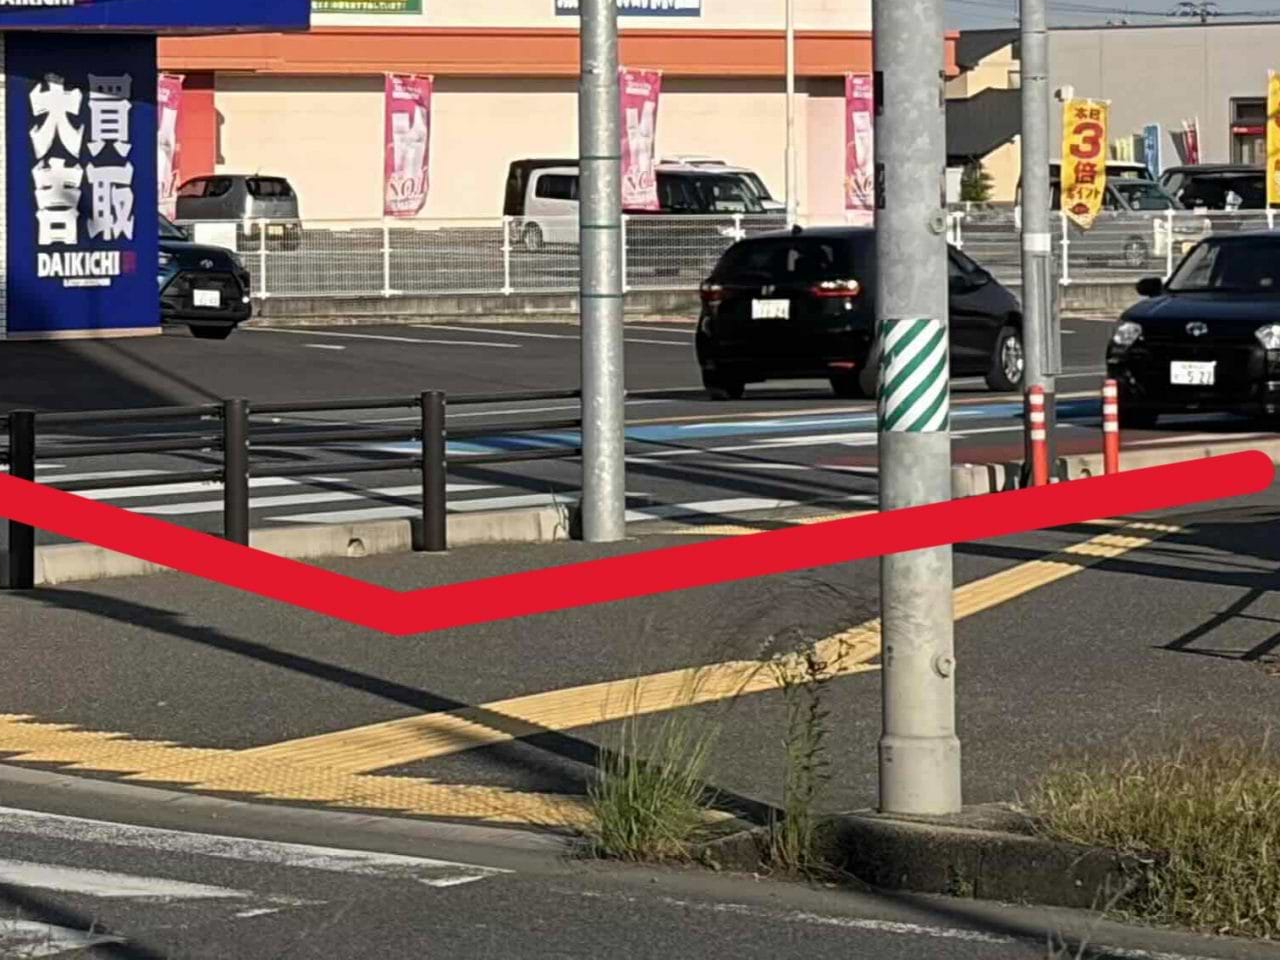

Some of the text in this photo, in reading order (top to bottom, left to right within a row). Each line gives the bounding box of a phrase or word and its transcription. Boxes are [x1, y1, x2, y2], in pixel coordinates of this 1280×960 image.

[28, 73, 85, 246] 大吉
[87, 73, 135, 241] 買取
[1069, 122, 1104, 160] 3
[1074, 161, 1098, 184] 倍
[37, 251, 120, 278] DAIKICHI
